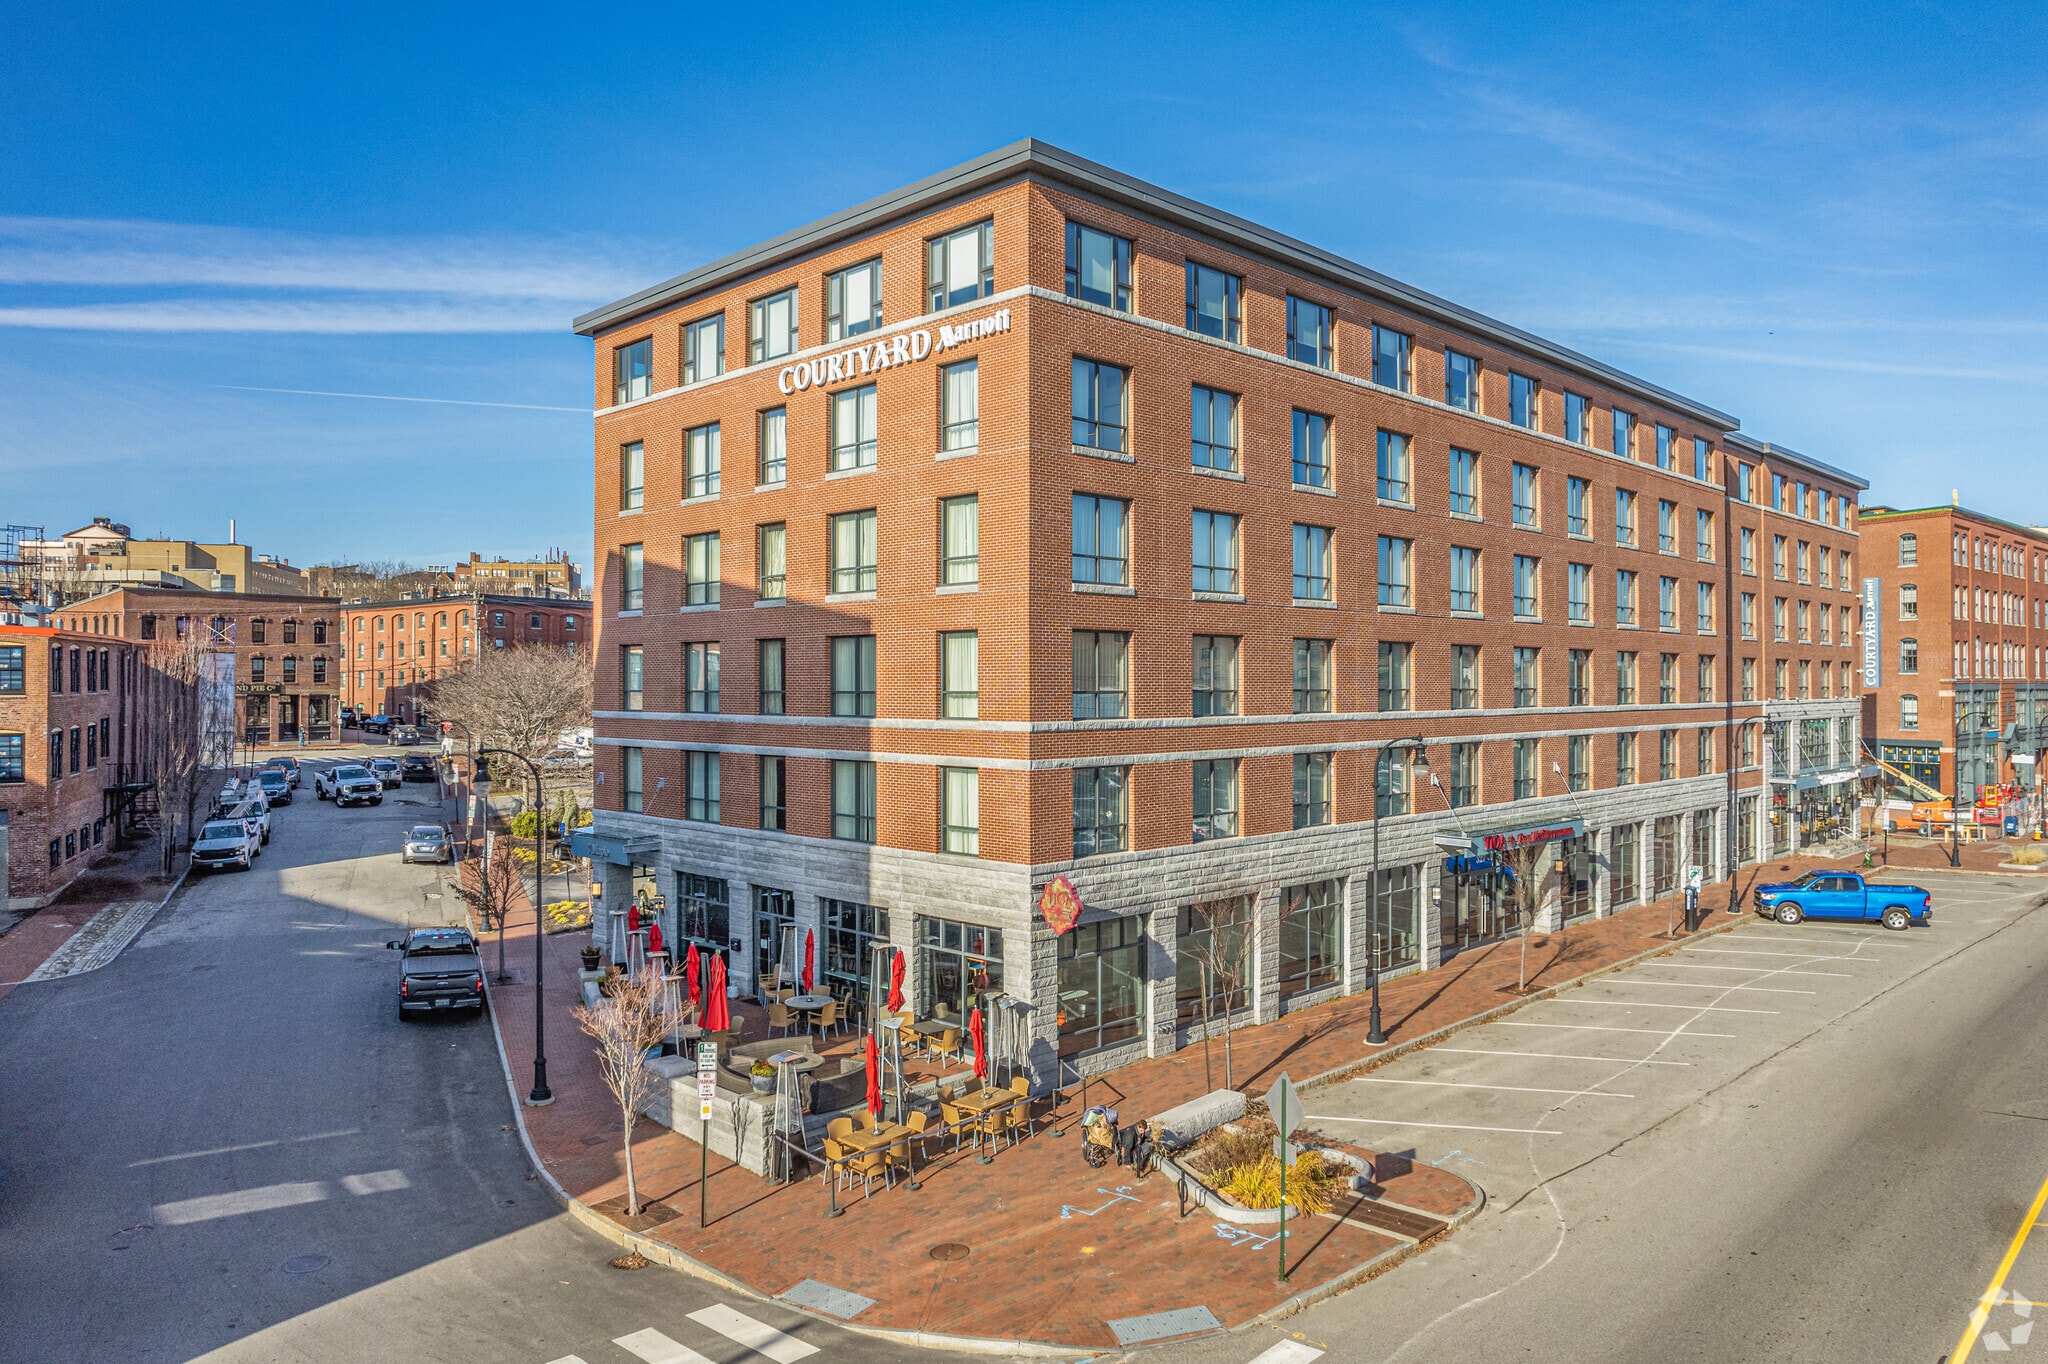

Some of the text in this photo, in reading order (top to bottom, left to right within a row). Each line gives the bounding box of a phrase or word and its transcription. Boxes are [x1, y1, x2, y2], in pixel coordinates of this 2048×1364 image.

[778, 311, 1012, 395] COURTYARD Marriott
[1865, 611, 1876, 686] COURTYARD
